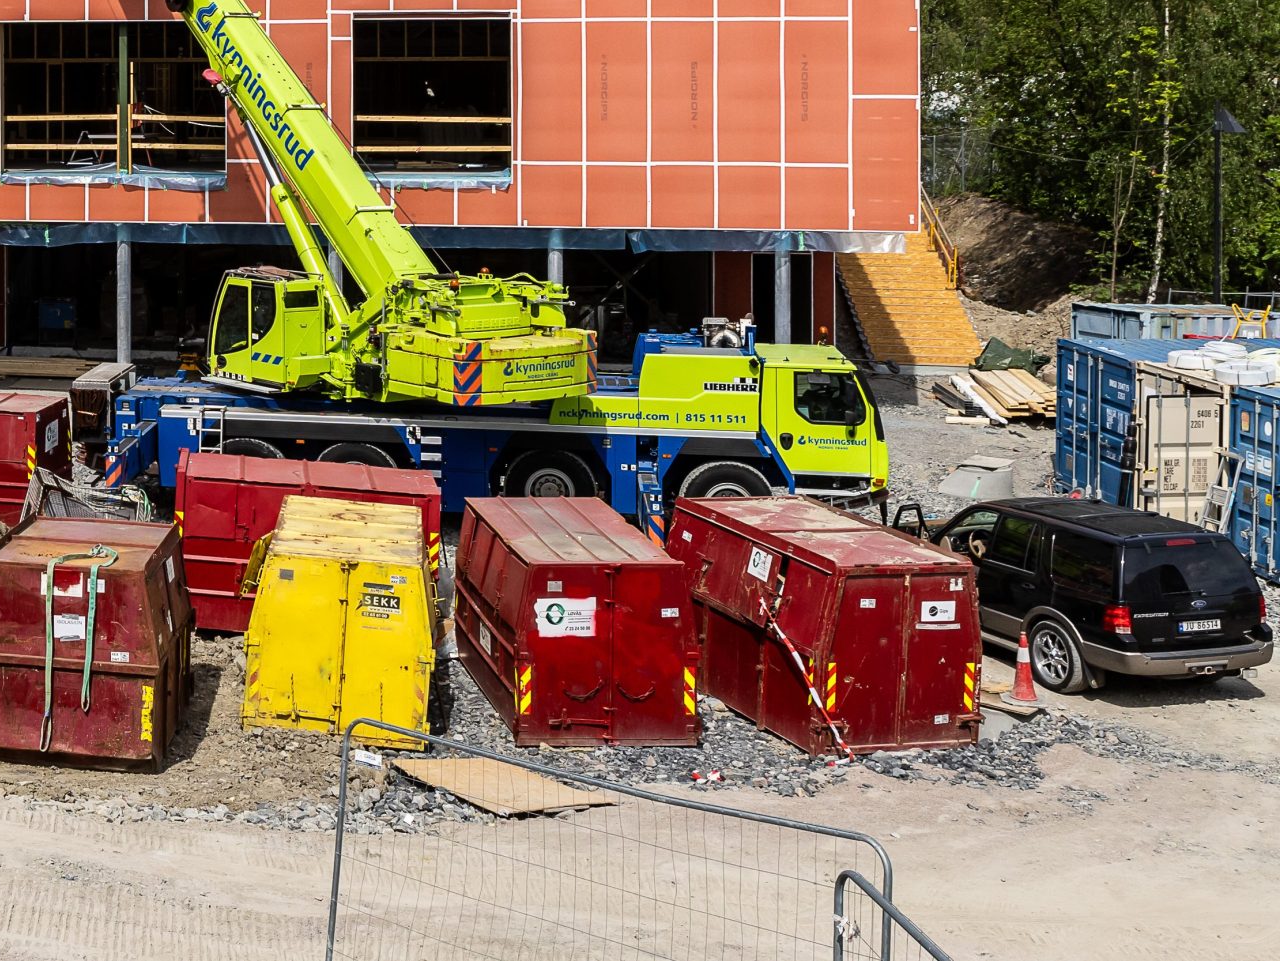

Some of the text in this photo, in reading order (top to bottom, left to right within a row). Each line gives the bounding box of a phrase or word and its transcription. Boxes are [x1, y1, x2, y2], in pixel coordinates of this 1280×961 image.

[212, 20, 315, 172] kynningsrud
[515, 356, 576, 375] kynningsrud
[703, 382, 758, 392] LIEBHERR
[685, 413, 746, 424] 815 11 511
[808, 436, 867, 447] kynningsrud
[364, 595, 398, 608] SEKK
[1185, 620, 1218, 630] JU 86514
